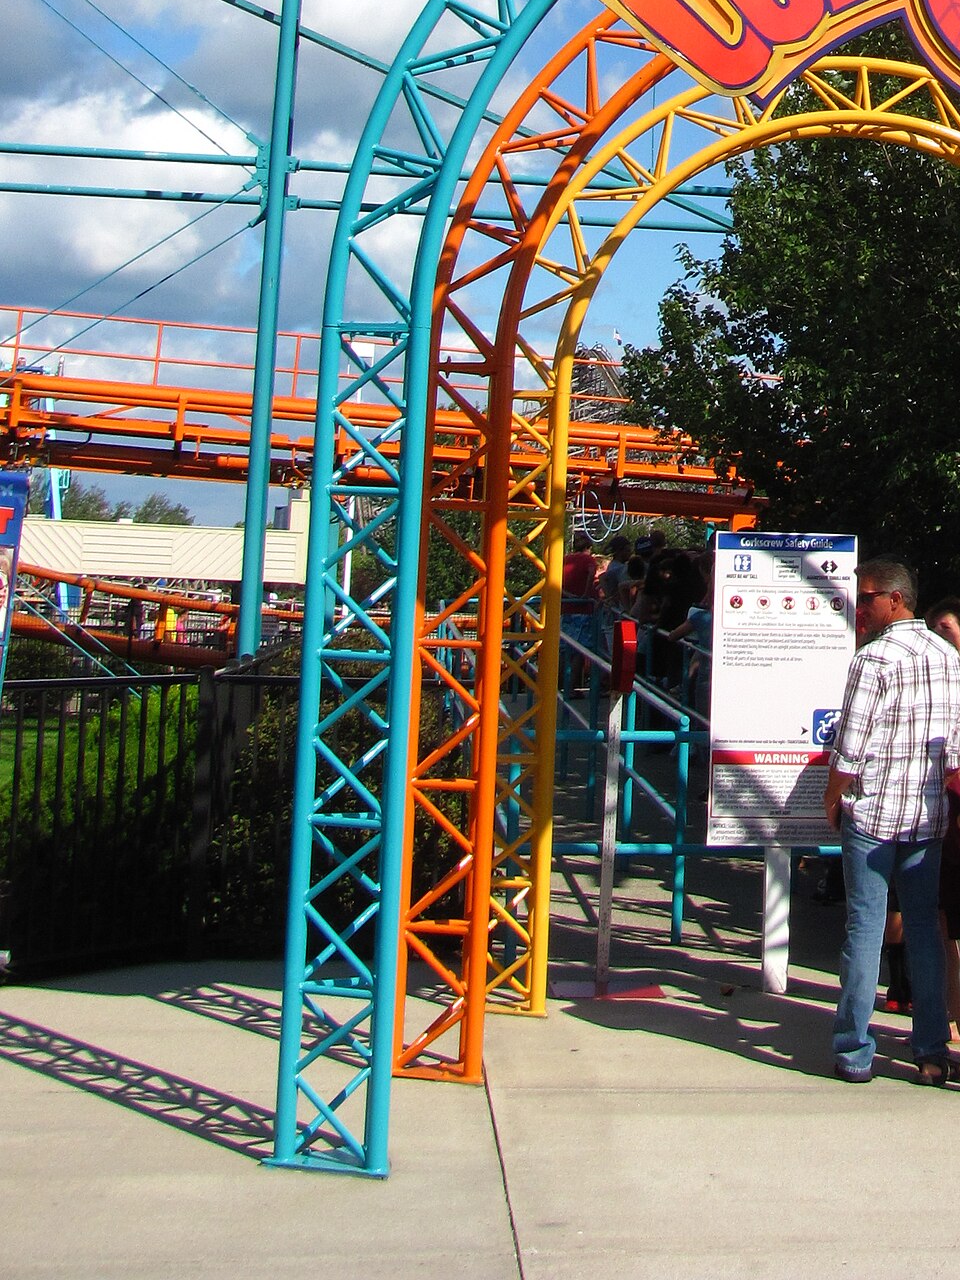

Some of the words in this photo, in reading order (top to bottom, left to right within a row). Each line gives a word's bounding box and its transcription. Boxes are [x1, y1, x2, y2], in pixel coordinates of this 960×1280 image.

[740, 537, 784, 548] Corkscrew
[785, 537, 810, 550] Safety
[810, 538, 833, 549] Guide
[754, 753, 809, 764] WARNING
